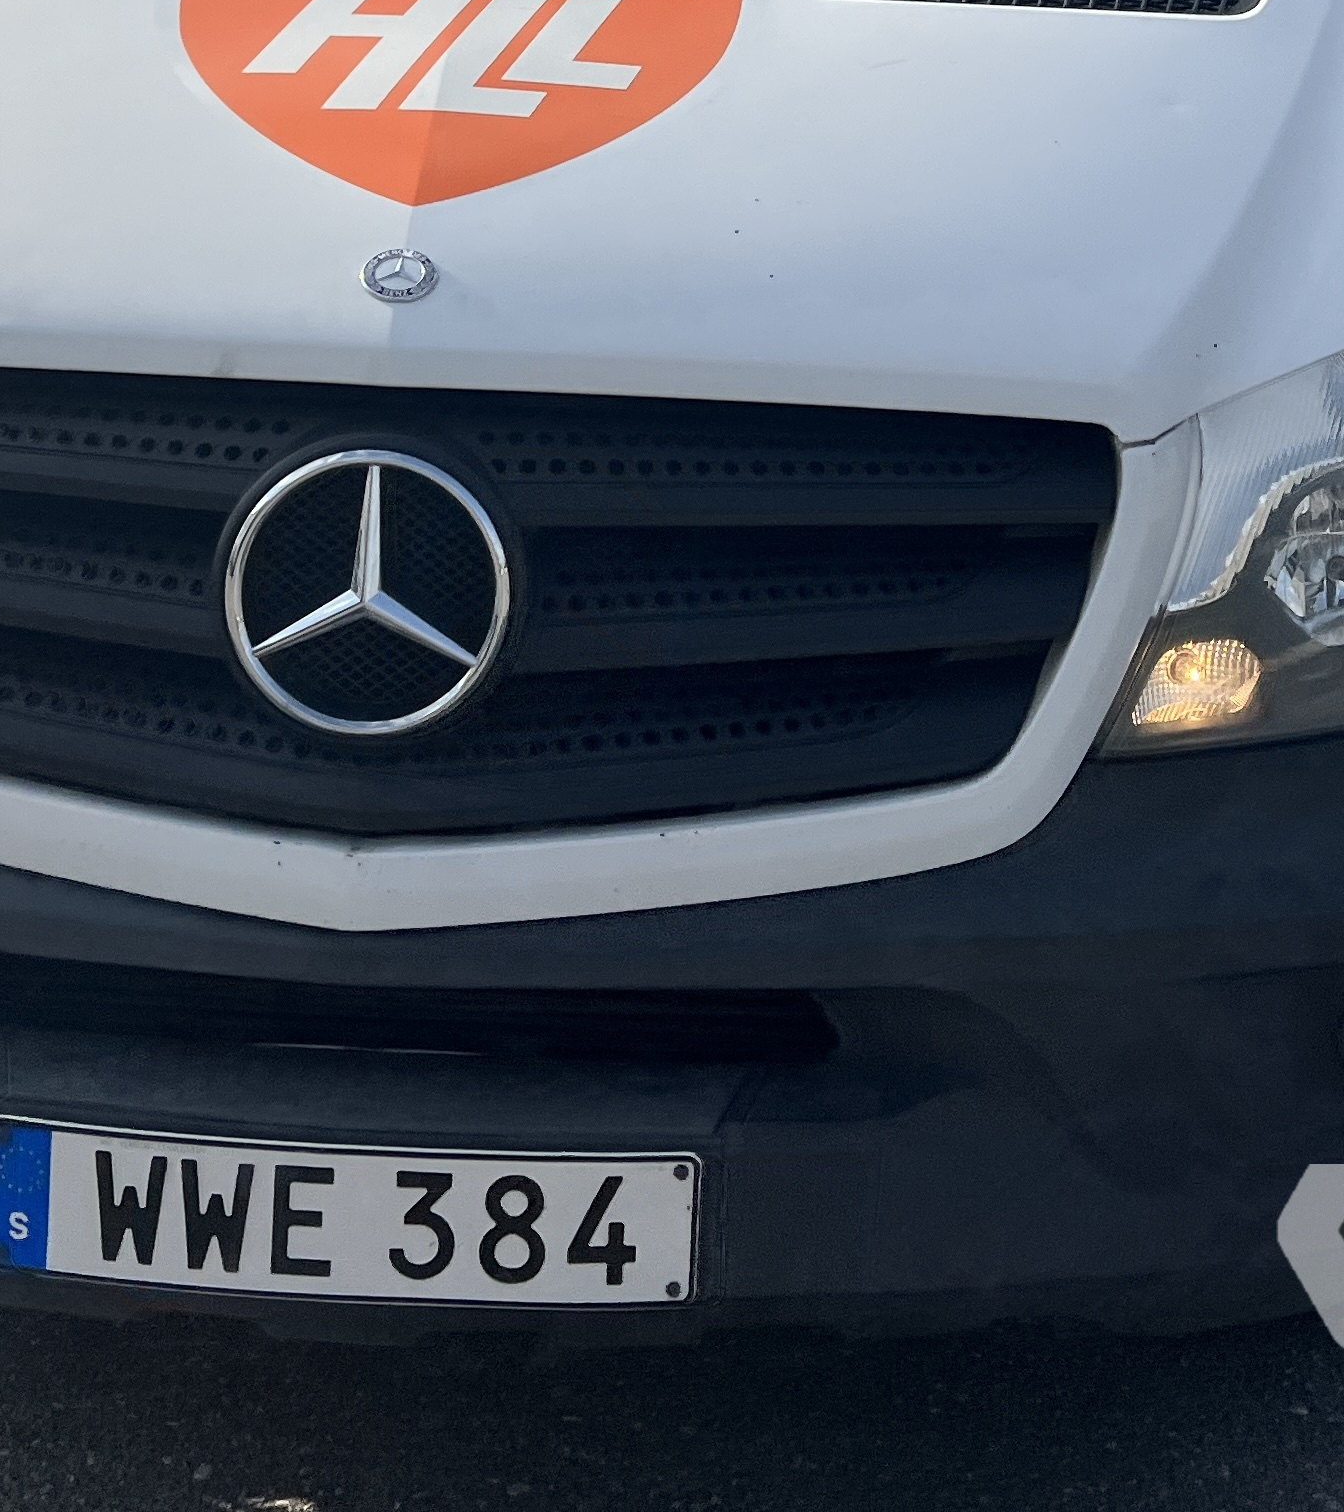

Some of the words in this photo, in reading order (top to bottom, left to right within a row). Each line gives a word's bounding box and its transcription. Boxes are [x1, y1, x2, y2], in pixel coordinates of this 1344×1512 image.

[9, 1211, 30, 1240] S
[94, 1149, 336, 1277] WWE
[389, 1170, 637, 1286] 384
